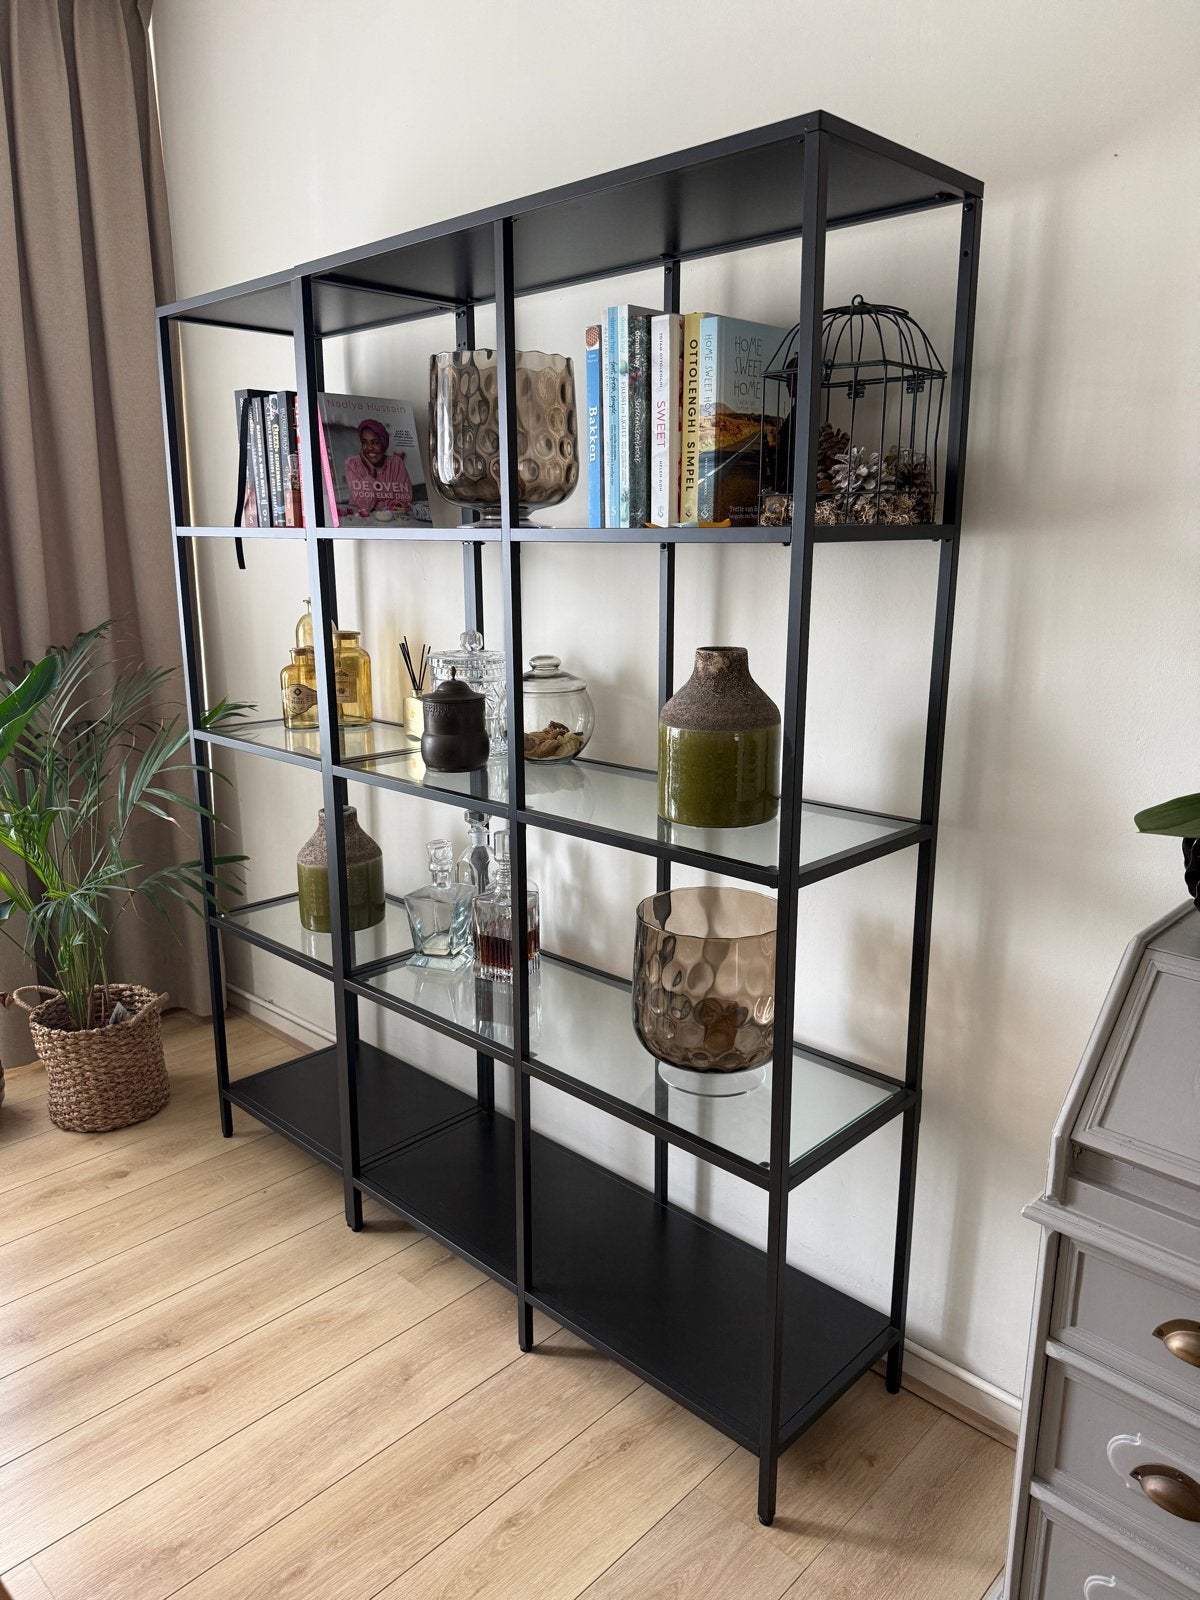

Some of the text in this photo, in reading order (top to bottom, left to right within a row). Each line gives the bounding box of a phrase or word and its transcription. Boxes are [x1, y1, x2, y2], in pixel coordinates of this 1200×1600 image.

[735, 336, 762, 356] HOME
[734, 357, 763, 378] SWEET
[703, 334, 713, 424] HOME SWEET HOME
[733, 380, 762, 399] HOME
[327, 399, 406, 414] Nadiya Hussain
[685, 339, 699, 492] OTTOLENGHI SIMPEL
[588, 406, 598, 462] Bakken
[656, 400, 666, 448] SWEET
[352, 480, 409, 492] DE OVEN
[353, 491, 375, 499] VOOR
[395, 493, 411, 501] DAG
